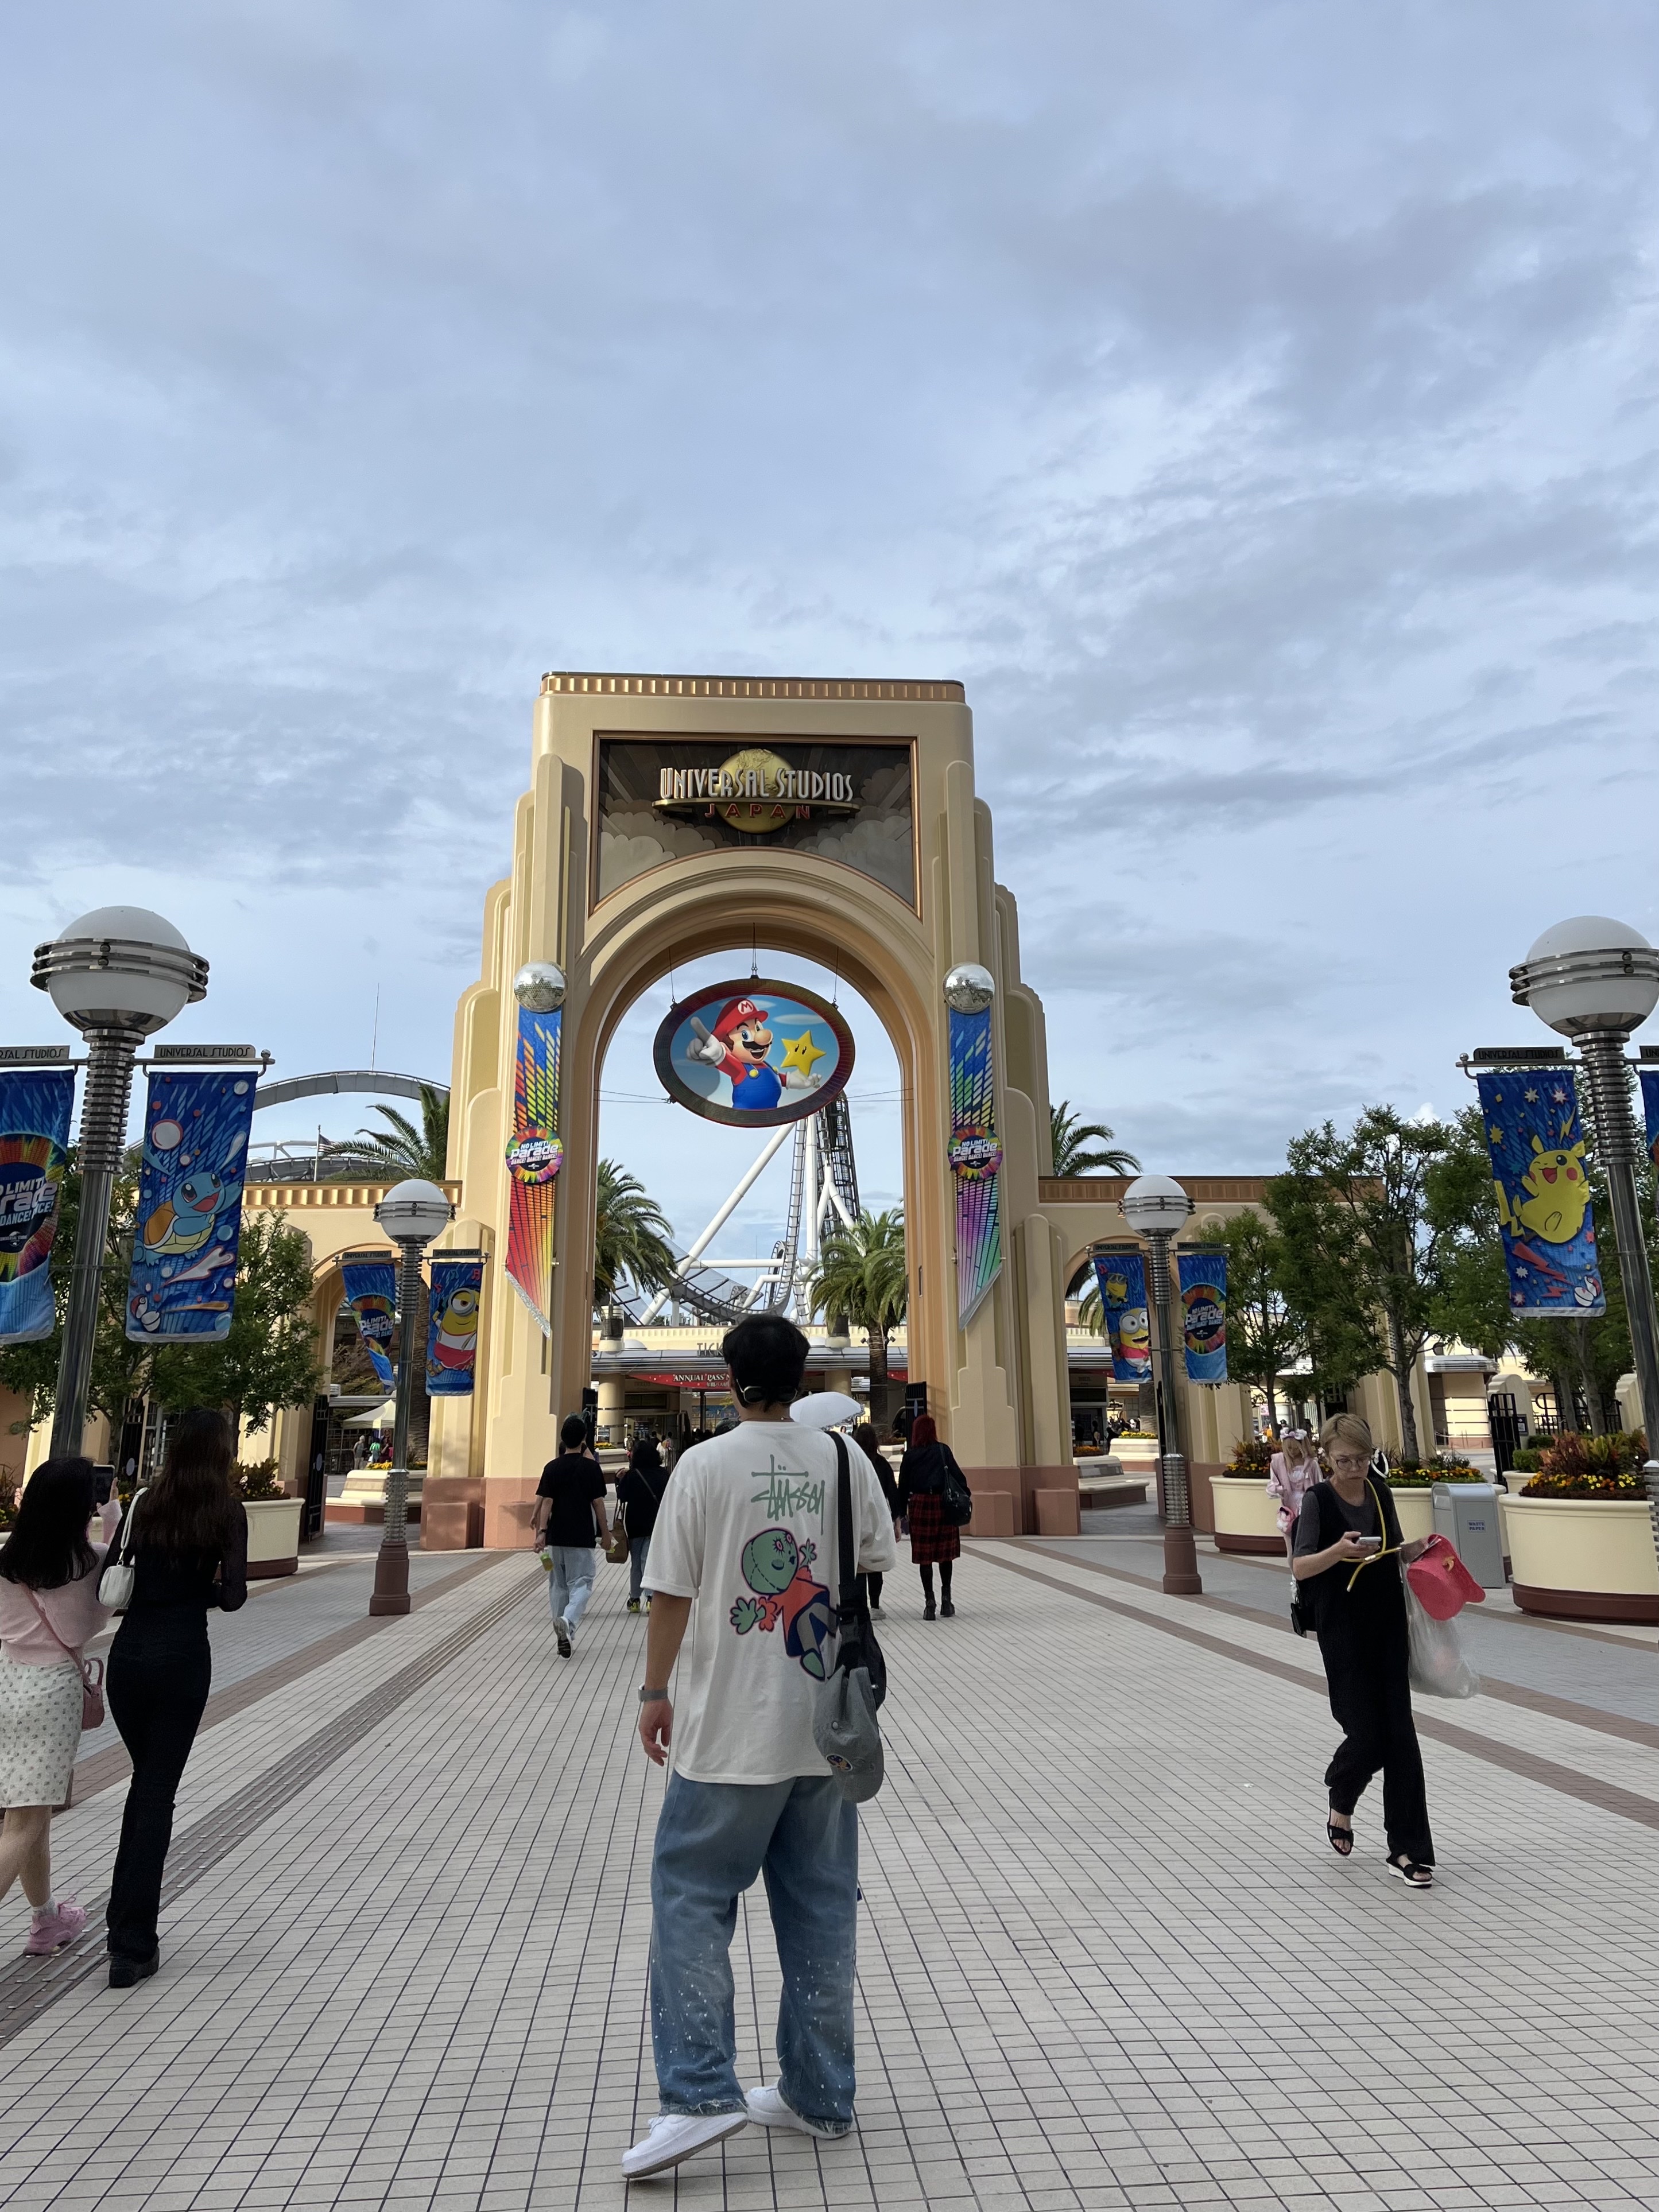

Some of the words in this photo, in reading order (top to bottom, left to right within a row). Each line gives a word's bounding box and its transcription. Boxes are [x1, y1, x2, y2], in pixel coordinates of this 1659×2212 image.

[660, 767, 770, 799] UNIVERSAL
[775, 768, 853, 801] STUDIOS
[704, 804, 810, 819] JAPAN
[22, 1048, 64, 1059] STUDIOS
[160, 1047, 208, 1057] UNIVERSAL
[210, 1047, 250, 1057] STUDIOS
[1479, 1050, 1522, 1060] UNIVERSAL
[697, 1342, 723, 1356] TICK
